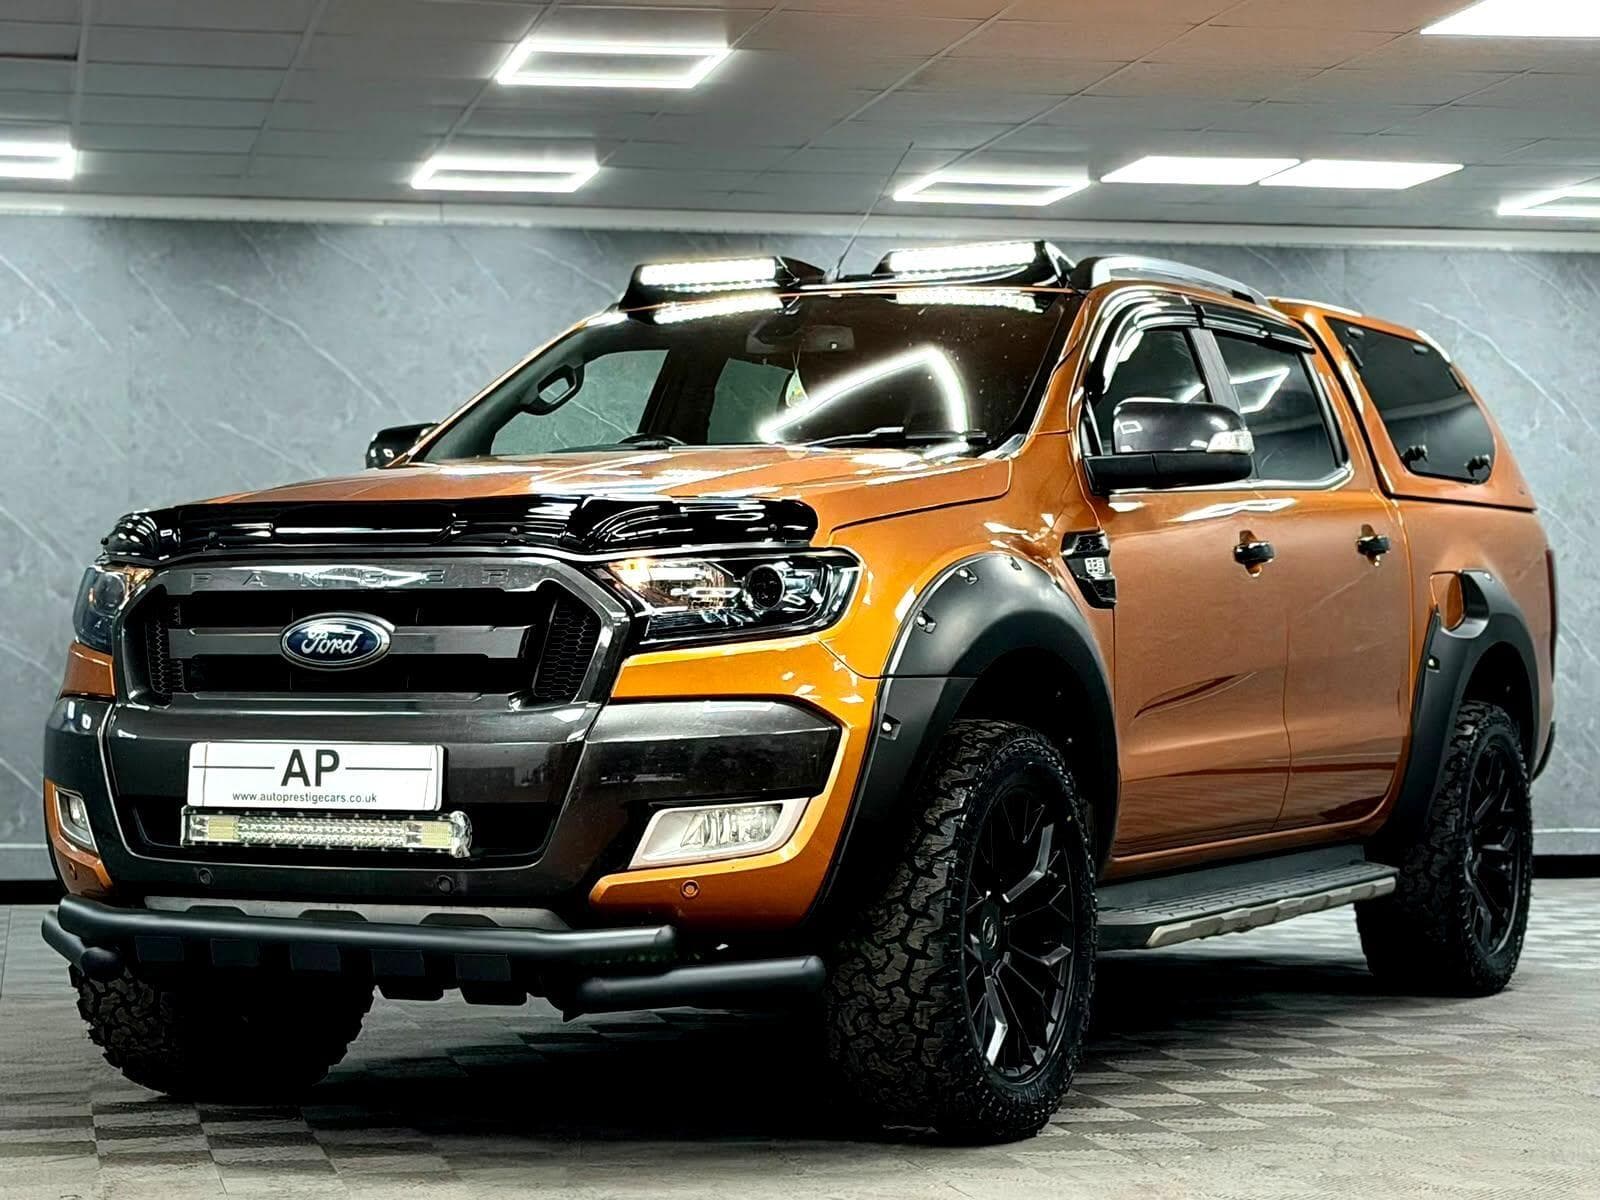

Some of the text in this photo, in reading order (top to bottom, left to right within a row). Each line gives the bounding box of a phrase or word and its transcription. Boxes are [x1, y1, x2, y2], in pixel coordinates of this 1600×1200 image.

[300, 627, 363, 654] Ford
[281, 749, 340, 787] AP
[232, 791, 377, 804] www.autoprestigecars.co.uk
